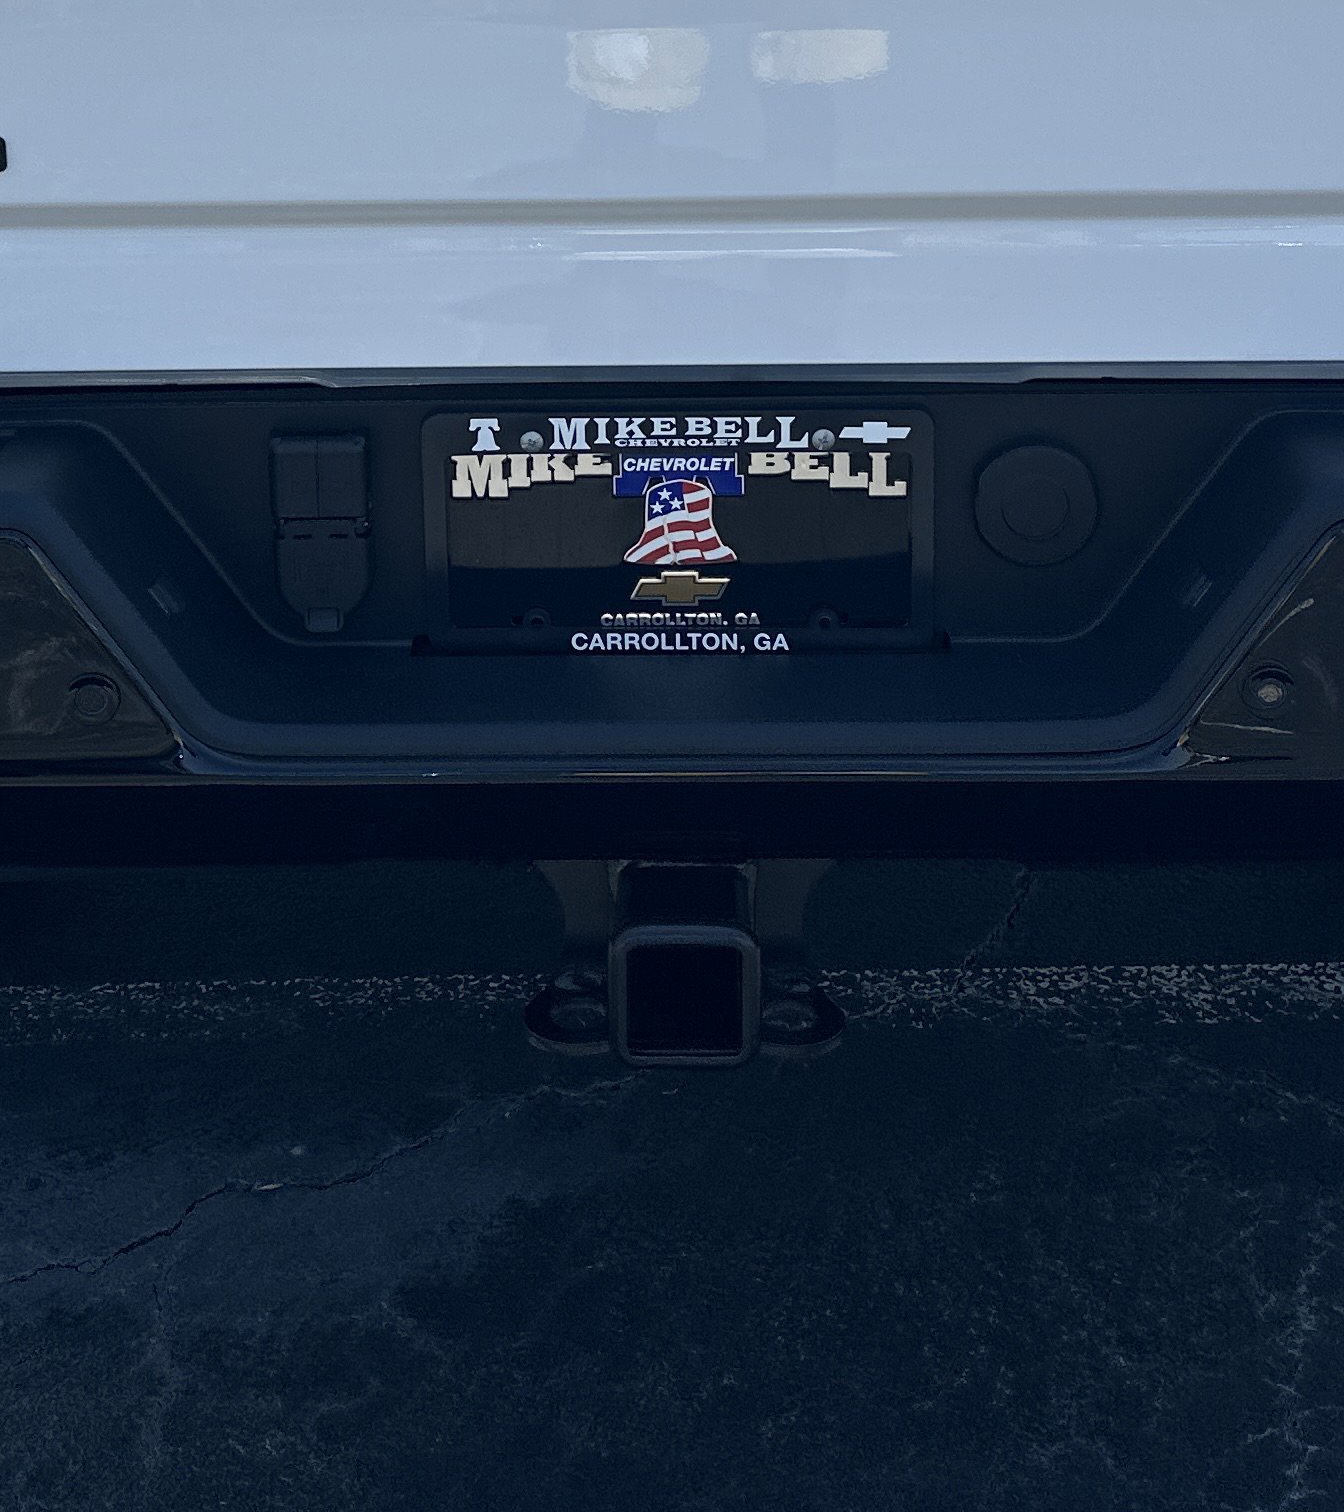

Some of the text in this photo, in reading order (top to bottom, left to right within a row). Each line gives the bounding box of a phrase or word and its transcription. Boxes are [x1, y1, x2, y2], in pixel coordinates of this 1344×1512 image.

[548, 416, 809, 450] MIKE BELL
[614, 438, 741, 447] CHEVROLET
[623, 457, 735, 472] CHEVROLET
[451, 451, 907, 498] MIKE BELL
[734, 612, 761, 626] GA
[571, 632, 790, 654] CARROLLTON, GA
